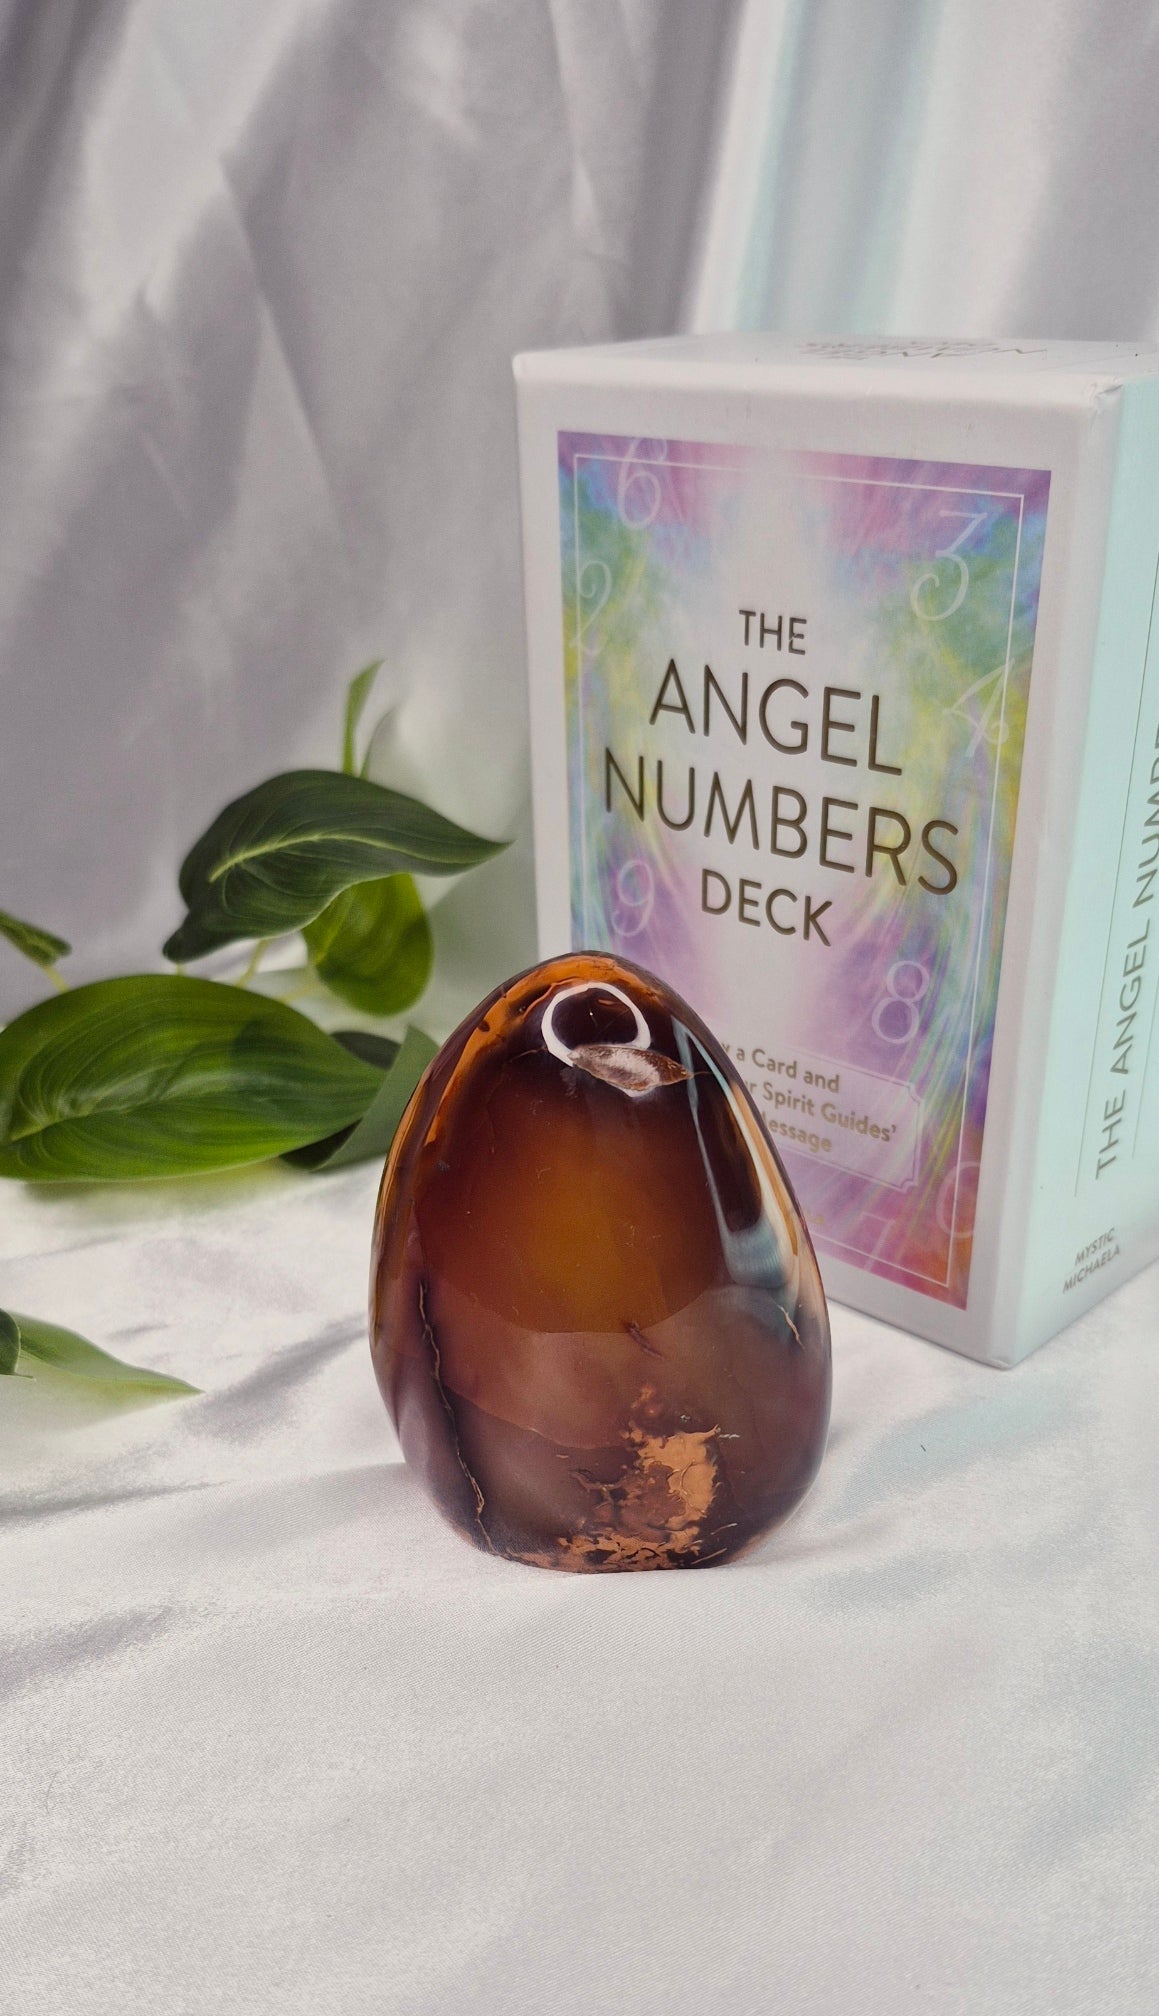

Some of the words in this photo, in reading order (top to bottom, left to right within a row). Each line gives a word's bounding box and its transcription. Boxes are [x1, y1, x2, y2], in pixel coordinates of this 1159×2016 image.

[910, 509, 988, 621] 3
[738, 608, 808, 656] THE
[649, 657, 903, 777] ANGEL
[602, 746, 959, 897] NUMBERS
[701, 868, 833, 948] DECK
[871, 959, 930, 1044] 8
[1109, 917, 1151, 1076] ANGEL
[735, 1047, 746, 1062] a
[751, 1047, 798, 1080] Card
[803, 1068, 841, 1094] and
[762, 1080, 816, 1117] Spirit
[761, 1110, 833, 1154] essage
[1094, 1089, 1127, 1181] THE
[1061, 1244, 1121, 1295] MICHAELA
[1074, 1226, 1116, 1267] MYSTIC
